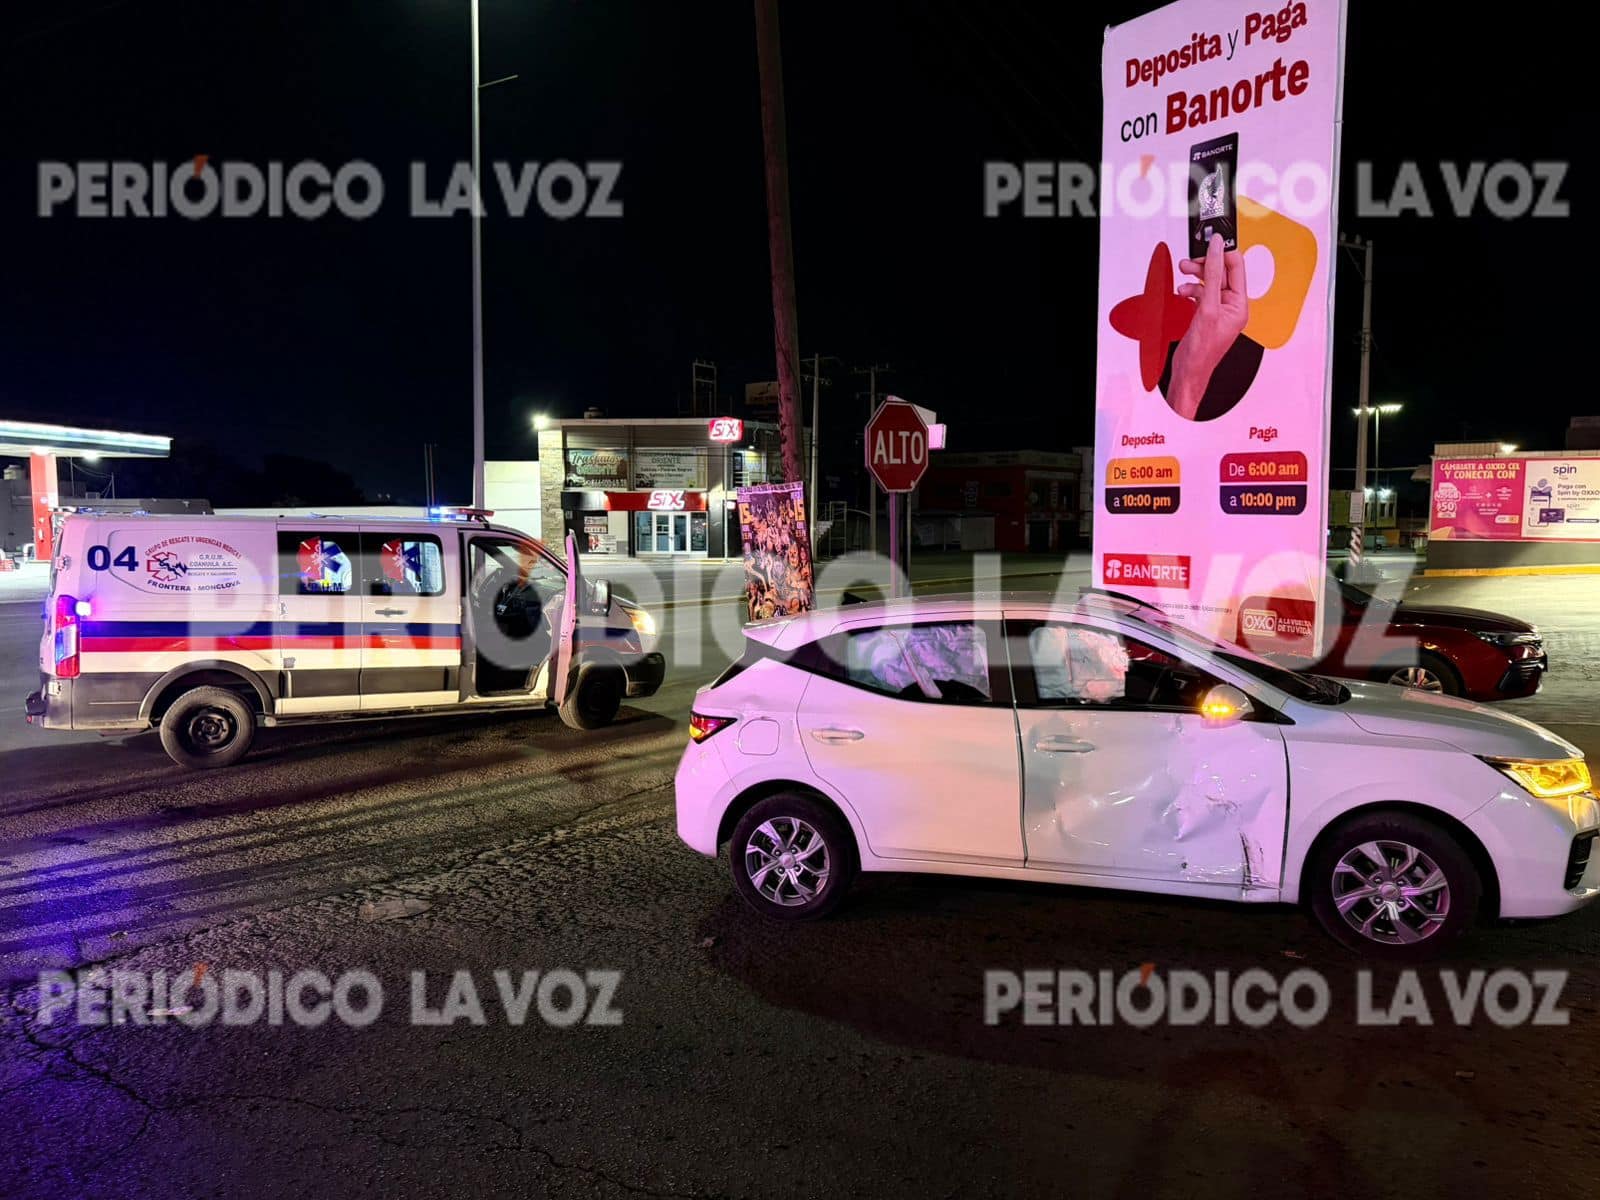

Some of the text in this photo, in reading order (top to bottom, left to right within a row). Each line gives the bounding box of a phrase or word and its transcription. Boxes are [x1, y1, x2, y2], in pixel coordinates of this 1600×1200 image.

[1125, 0, 1307, 88] Deposita y Paga
[1120, 56, 1310, 142] con Banorte
[1202, 144, 1233, 158] BANORTE
[1121, 432, 1165, 448] Deposita
[1249, 426, 1278, 442] Paga
[873, 430, 924, 465] ALTO
[1113, 466, 1173, 480] De 6:00 am
[1229, 462, 1299, 476] De 6:00 am
[1445, 470, 1516, 479] Y CONECTA CON
[1553, 464, 1577, 475] spin
[1113, 494, 1171, 510] a 10:00 pm
[1229, 494, 1296, 510] a 10:00 pm
[161, 540, 169, 548] DE
[168, 536, 190, 545] RESCATE
[195, 536, 222, 548] URGENCIAS
[87, 545, 139, 572] 04
[1123, 562, 1188, 581] BANORTE
[147, 579, 241, 591] FRONTERA MONCLOVA
[1244, 615, 1275, 631] OXXO
